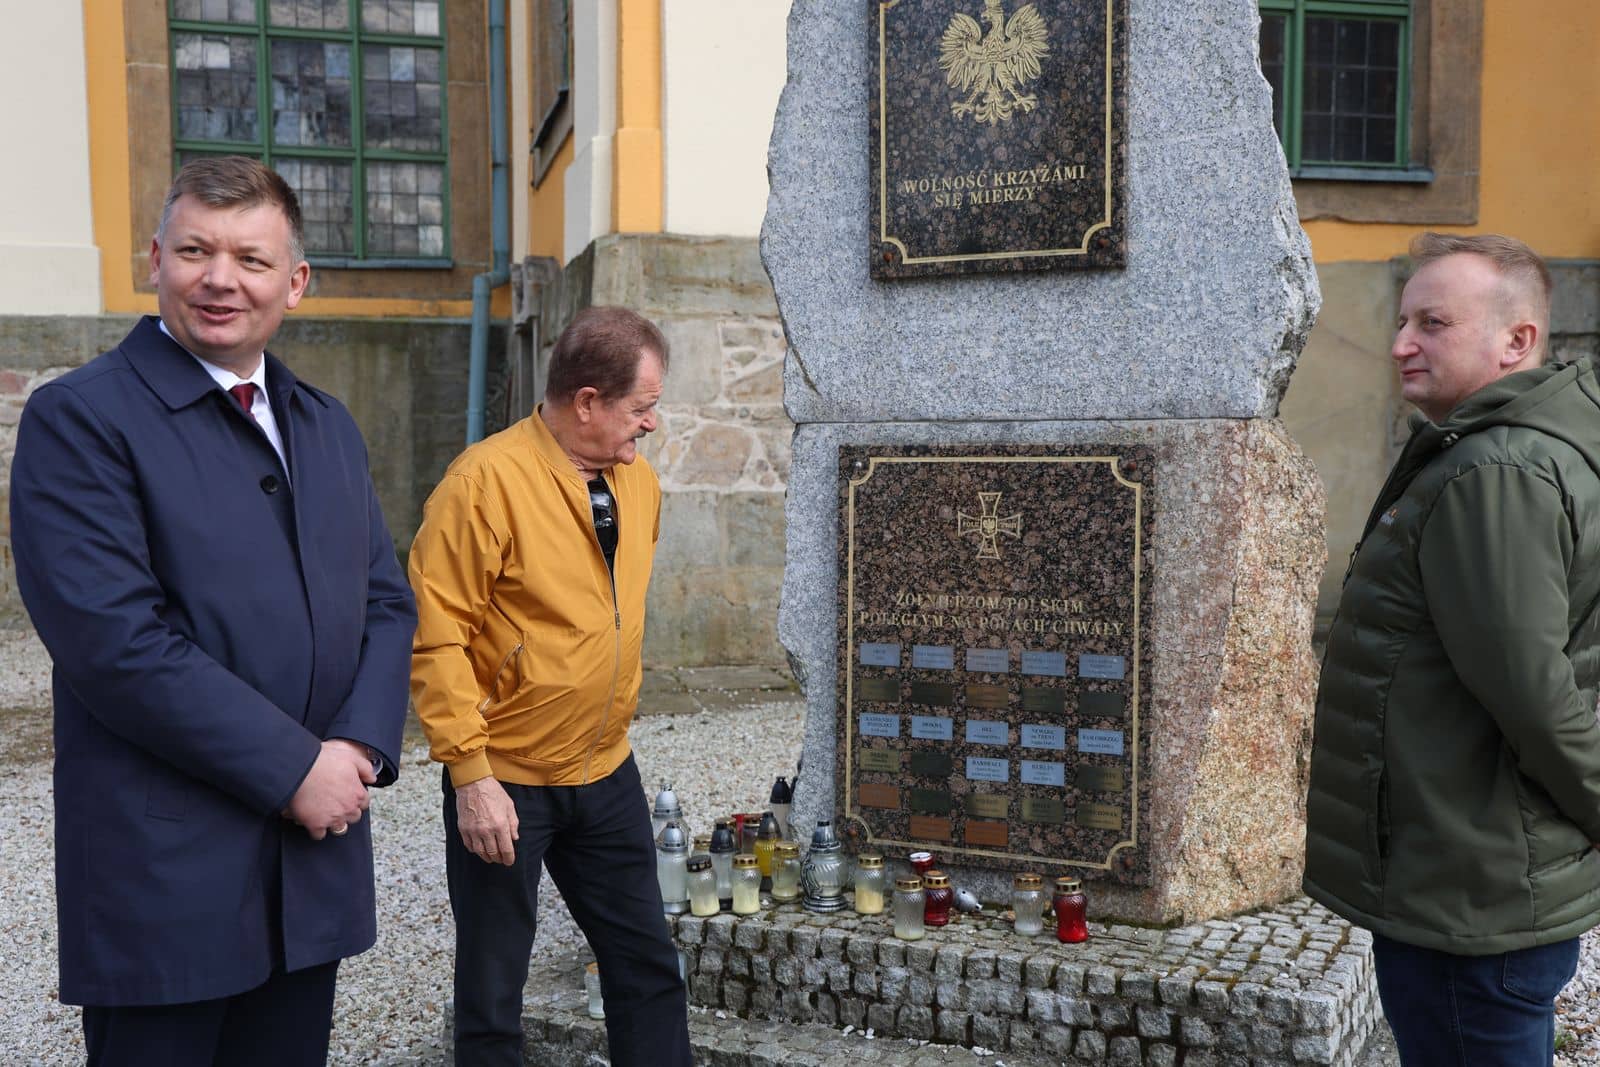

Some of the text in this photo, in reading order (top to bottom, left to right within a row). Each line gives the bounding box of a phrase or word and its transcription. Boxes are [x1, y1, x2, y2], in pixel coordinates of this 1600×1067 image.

[904, 164, 1086, 193] WOLNOŚĆ KRZYŻAMI
[934, 192, 963, 210] SIĘ
[1007, 597, 1083, 613] POLSKIM
[860, 611, 1124, 635] POLEGŁYM NA POLACH CHWAŁY
